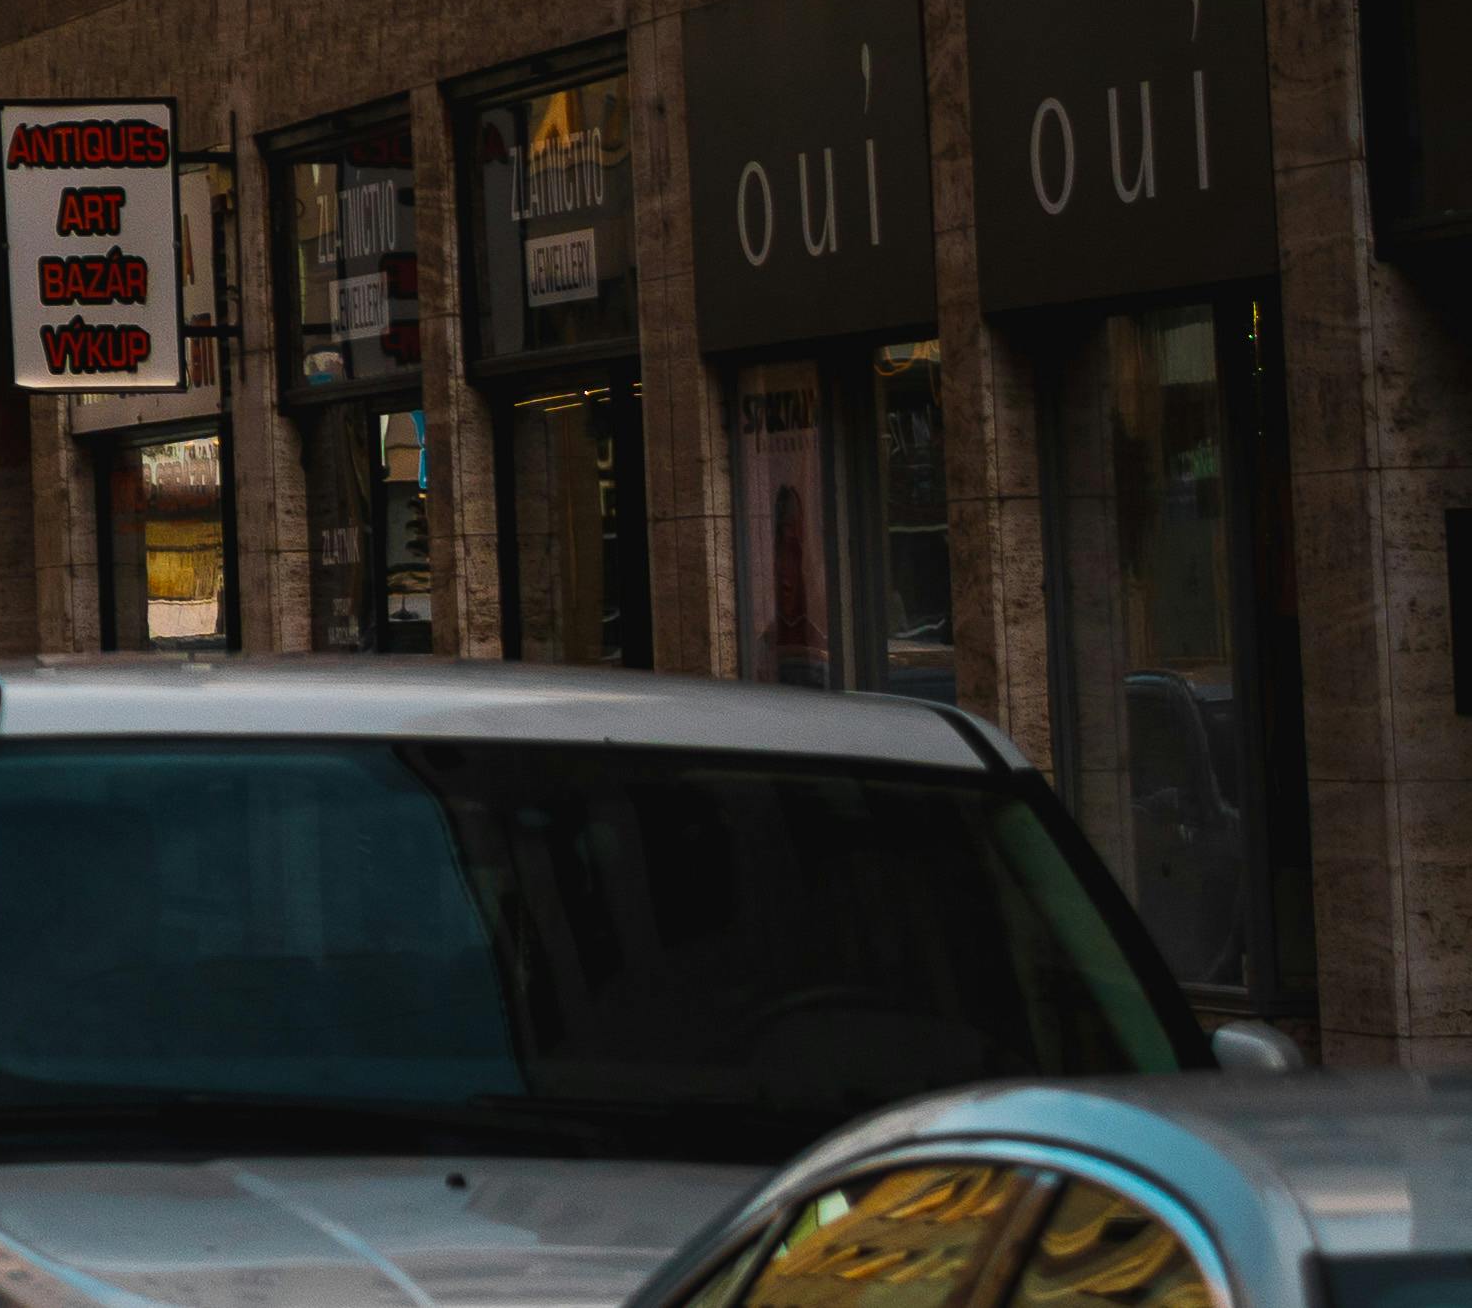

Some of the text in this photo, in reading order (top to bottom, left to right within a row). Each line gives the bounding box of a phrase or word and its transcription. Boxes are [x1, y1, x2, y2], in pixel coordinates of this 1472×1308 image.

[7, 120, 169, 169] ANTIQUES
[736, 42, 881, 268] oui
[57, 186, 125, 237] ART
[38, 245, 148, 305] BAZÁR
[531, 241, 593, 298] JEWELLERY
[40, 314, 150, 374] VÝKUP
